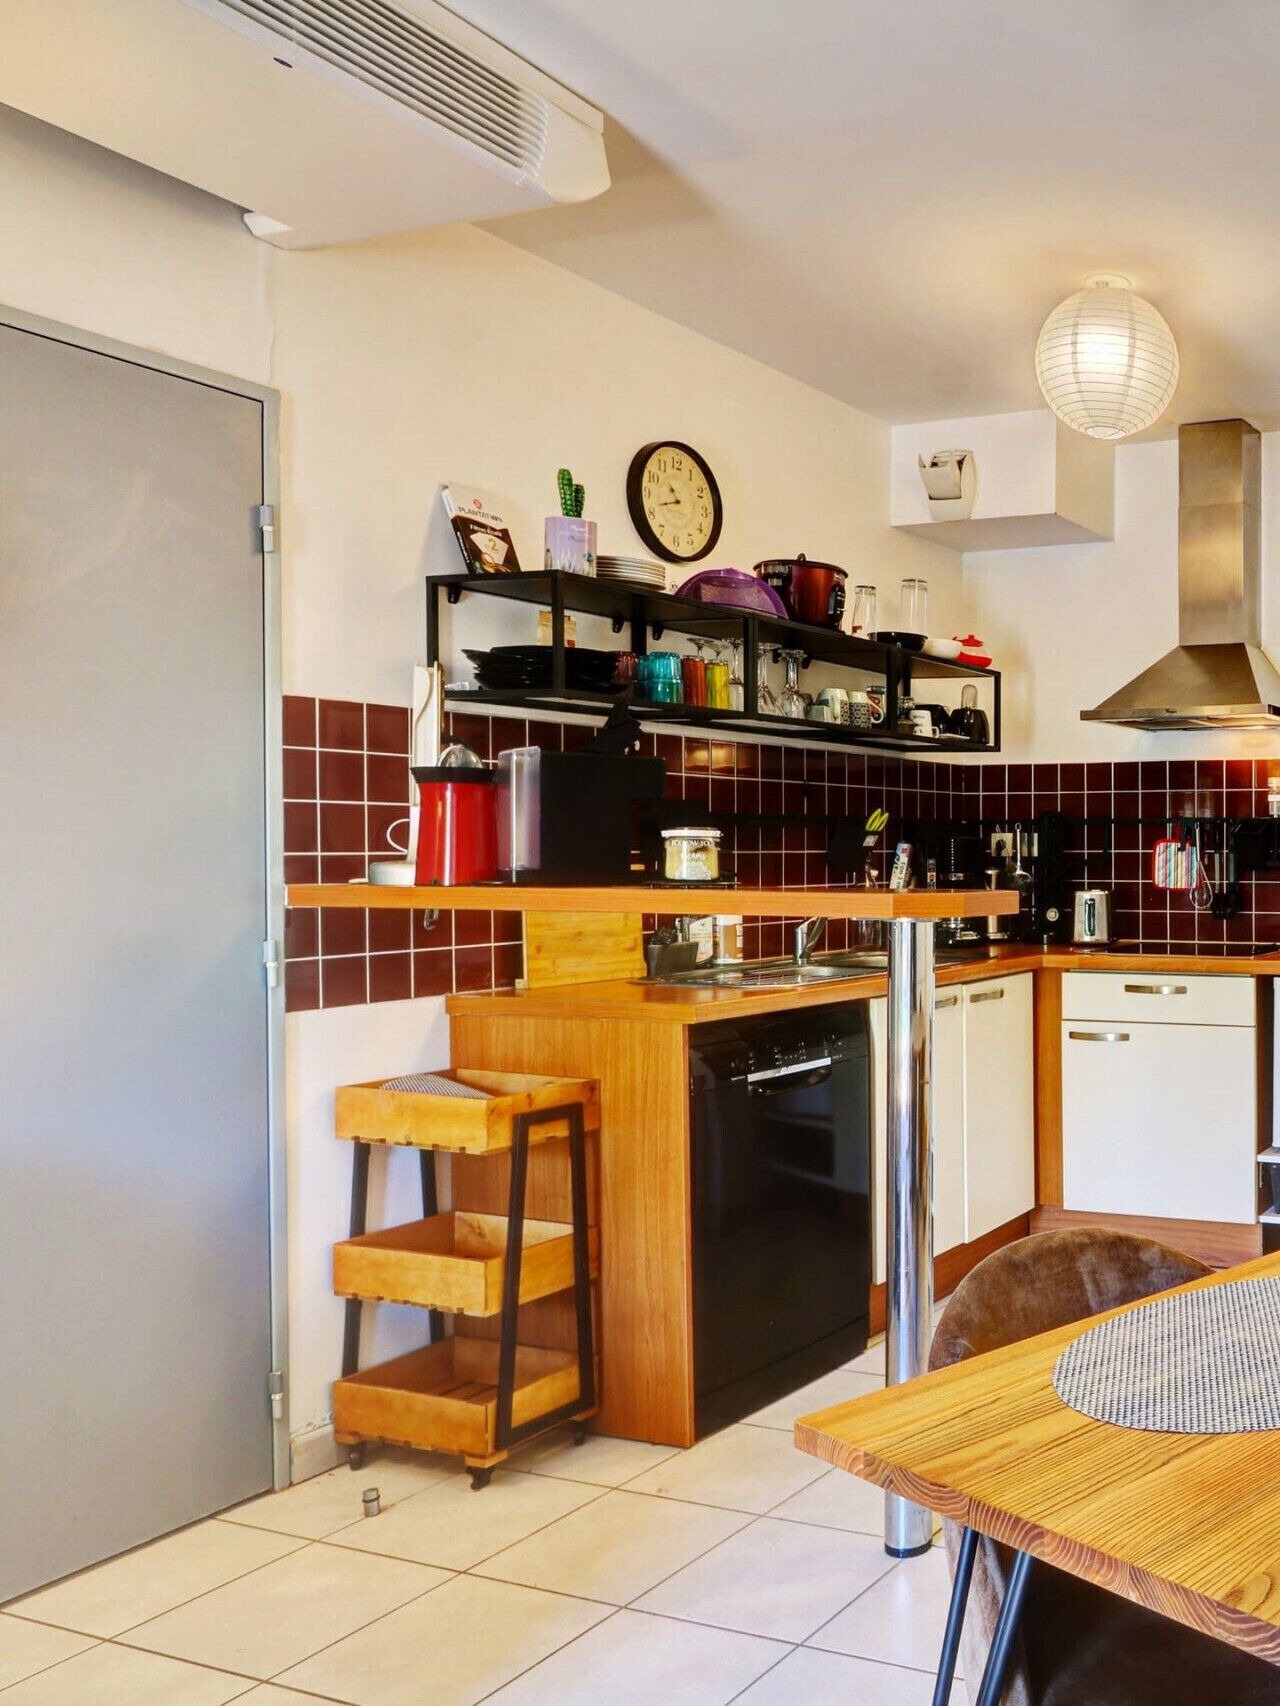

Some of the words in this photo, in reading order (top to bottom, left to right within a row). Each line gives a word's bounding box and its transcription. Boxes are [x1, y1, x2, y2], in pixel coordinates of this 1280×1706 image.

[657, 458, 667, 473] 11
[671, 456, 682, 471] 12
[648, 470, 659, 484] 10
[697, 486, 704, 499] 2
[648, 506, 656, 520] 8
[701, 506, 708, 518] 3
[658, 524, 665, 537] 7
[697, 521, 703, 534] 4
[672, 534, 680, 548] 6
[686, 533, 694, 546] 5
